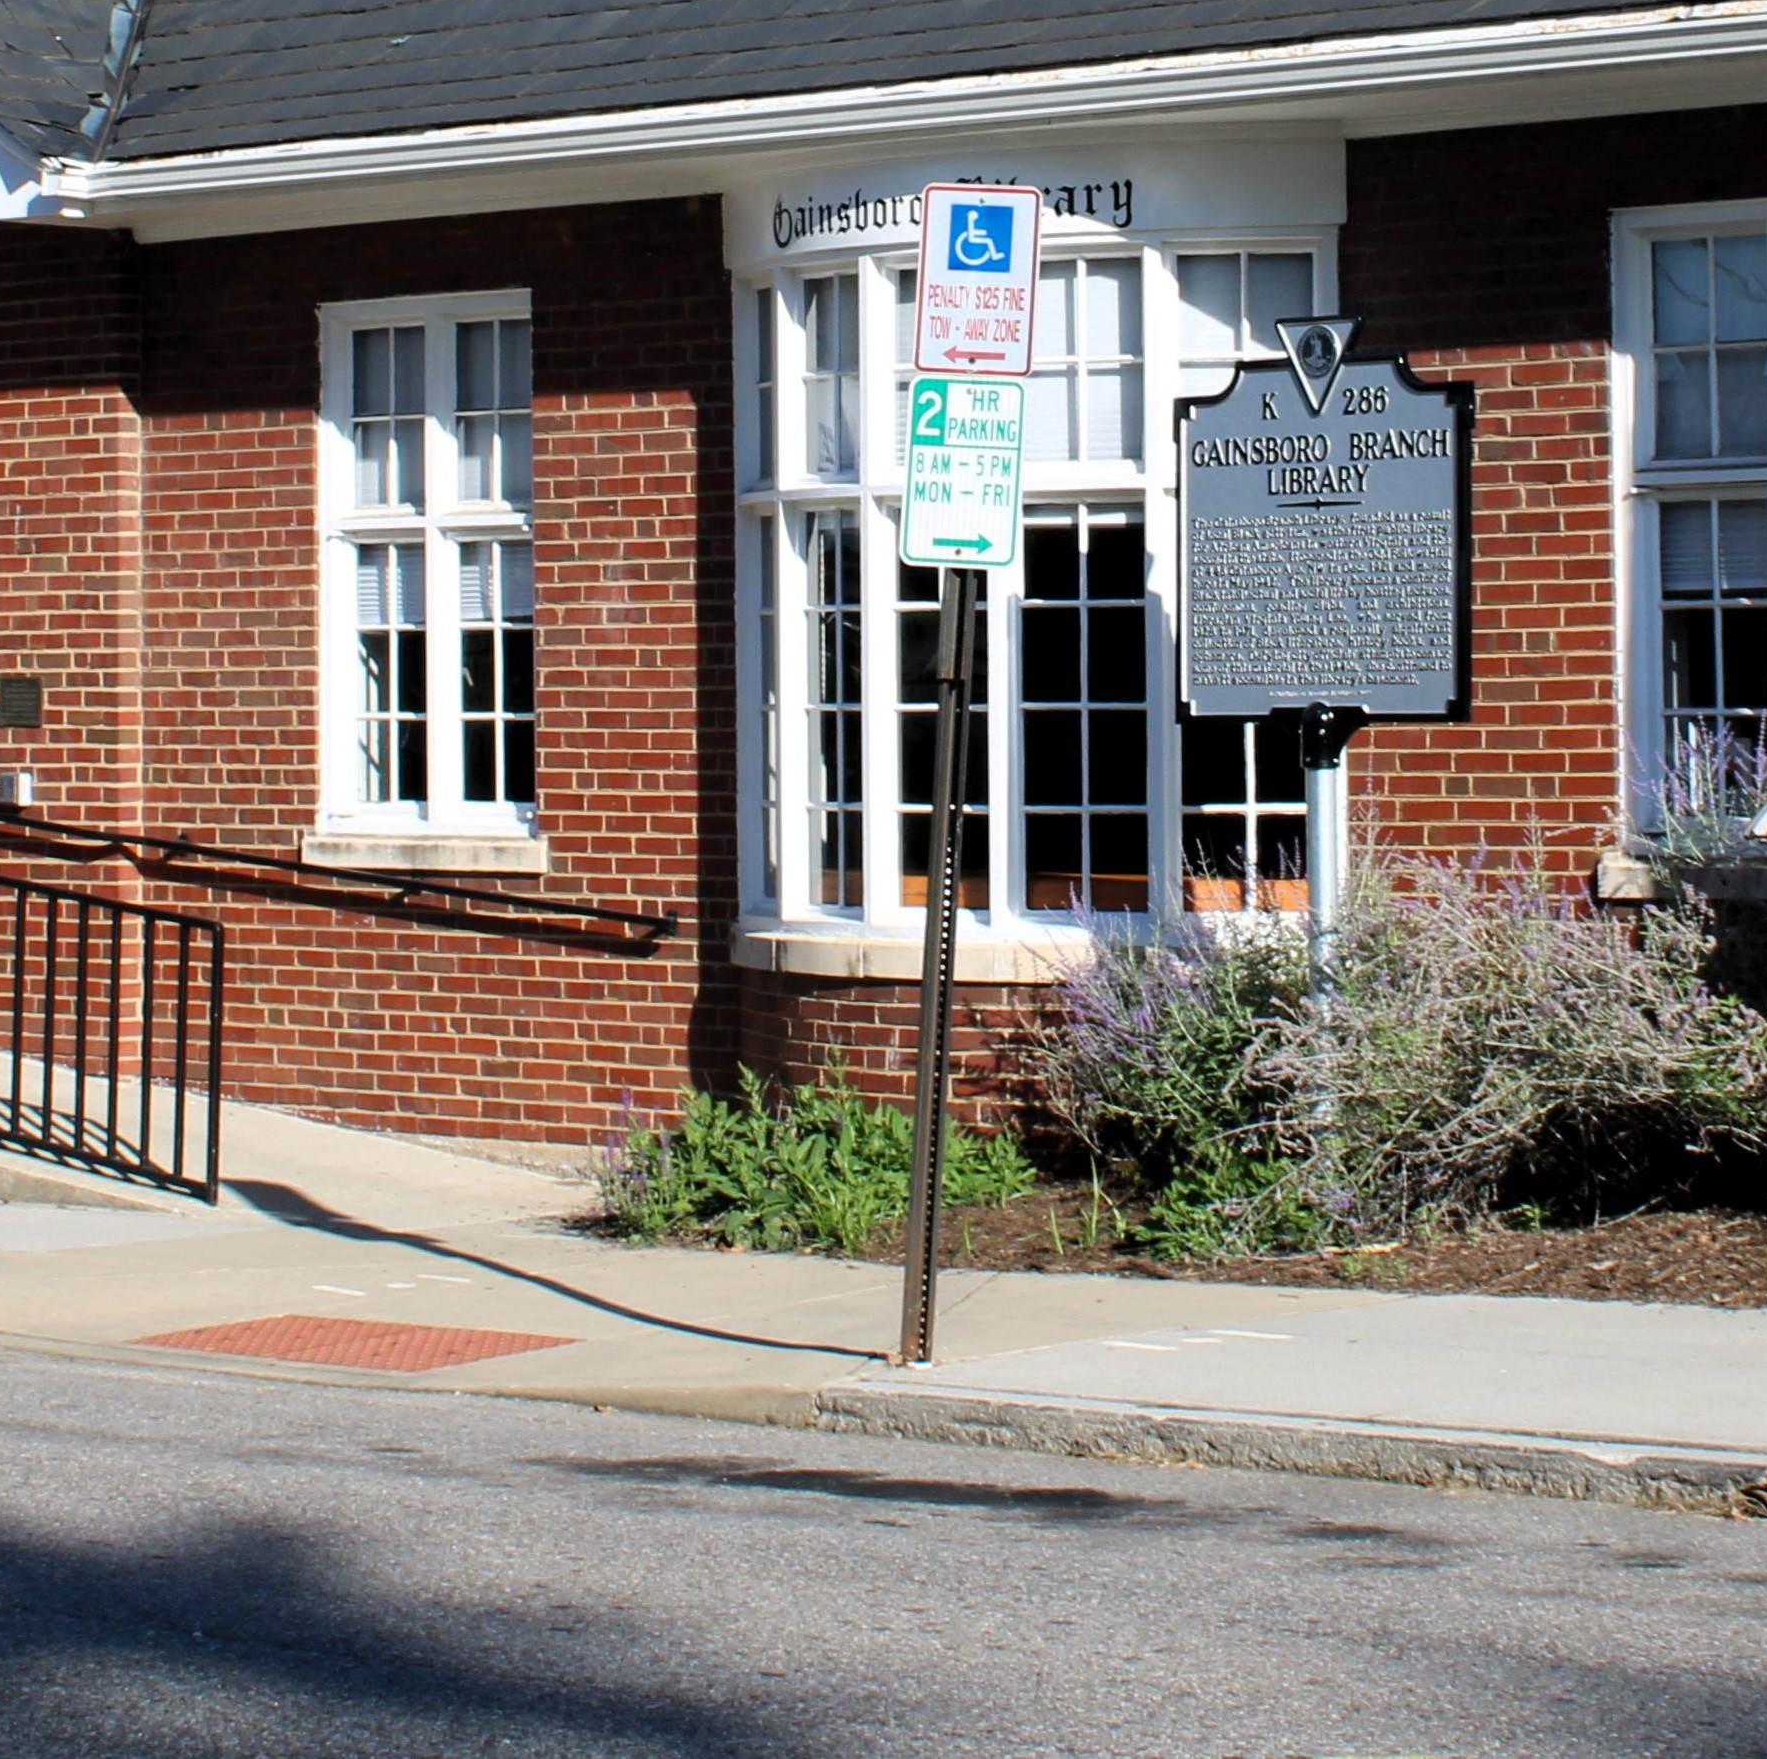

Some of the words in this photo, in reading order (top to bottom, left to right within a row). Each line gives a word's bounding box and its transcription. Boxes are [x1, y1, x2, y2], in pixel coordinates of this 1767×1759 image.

[773, 188, 922, 248] Gainsboro
[927, 284, 970, 309] PENALTY
[975, 286, 1000, 310] $125
[1002, 288, 1025, 311] FINE
[930, 315, 952, 340] TOW
[964, 318, 990, 341] AWAY
[993, 318, 1021, 343] ZONE
[915, 390, 943, 436] 2
[971, 389, 1000, 412] HR
[1261, 391, 1279, 420] K
[1342, 385, 1389, 415] 286
[947, 417, 1017, 442] PARKING
[1191, 431, 1331, 467] GAINSBORO
[1349, 427, 1452, 461] BRANCH
[915, 452, 925, 474] 8
[930, 452, 952, 475] AM
[976, 455, 985, 477] 5
[990, 456, 1012, 478] PM
[1266, 463, 1372, 496] LIBRARY
[914, 480, 953, 504] MON
[982, 483, 1011, 507] FRI
